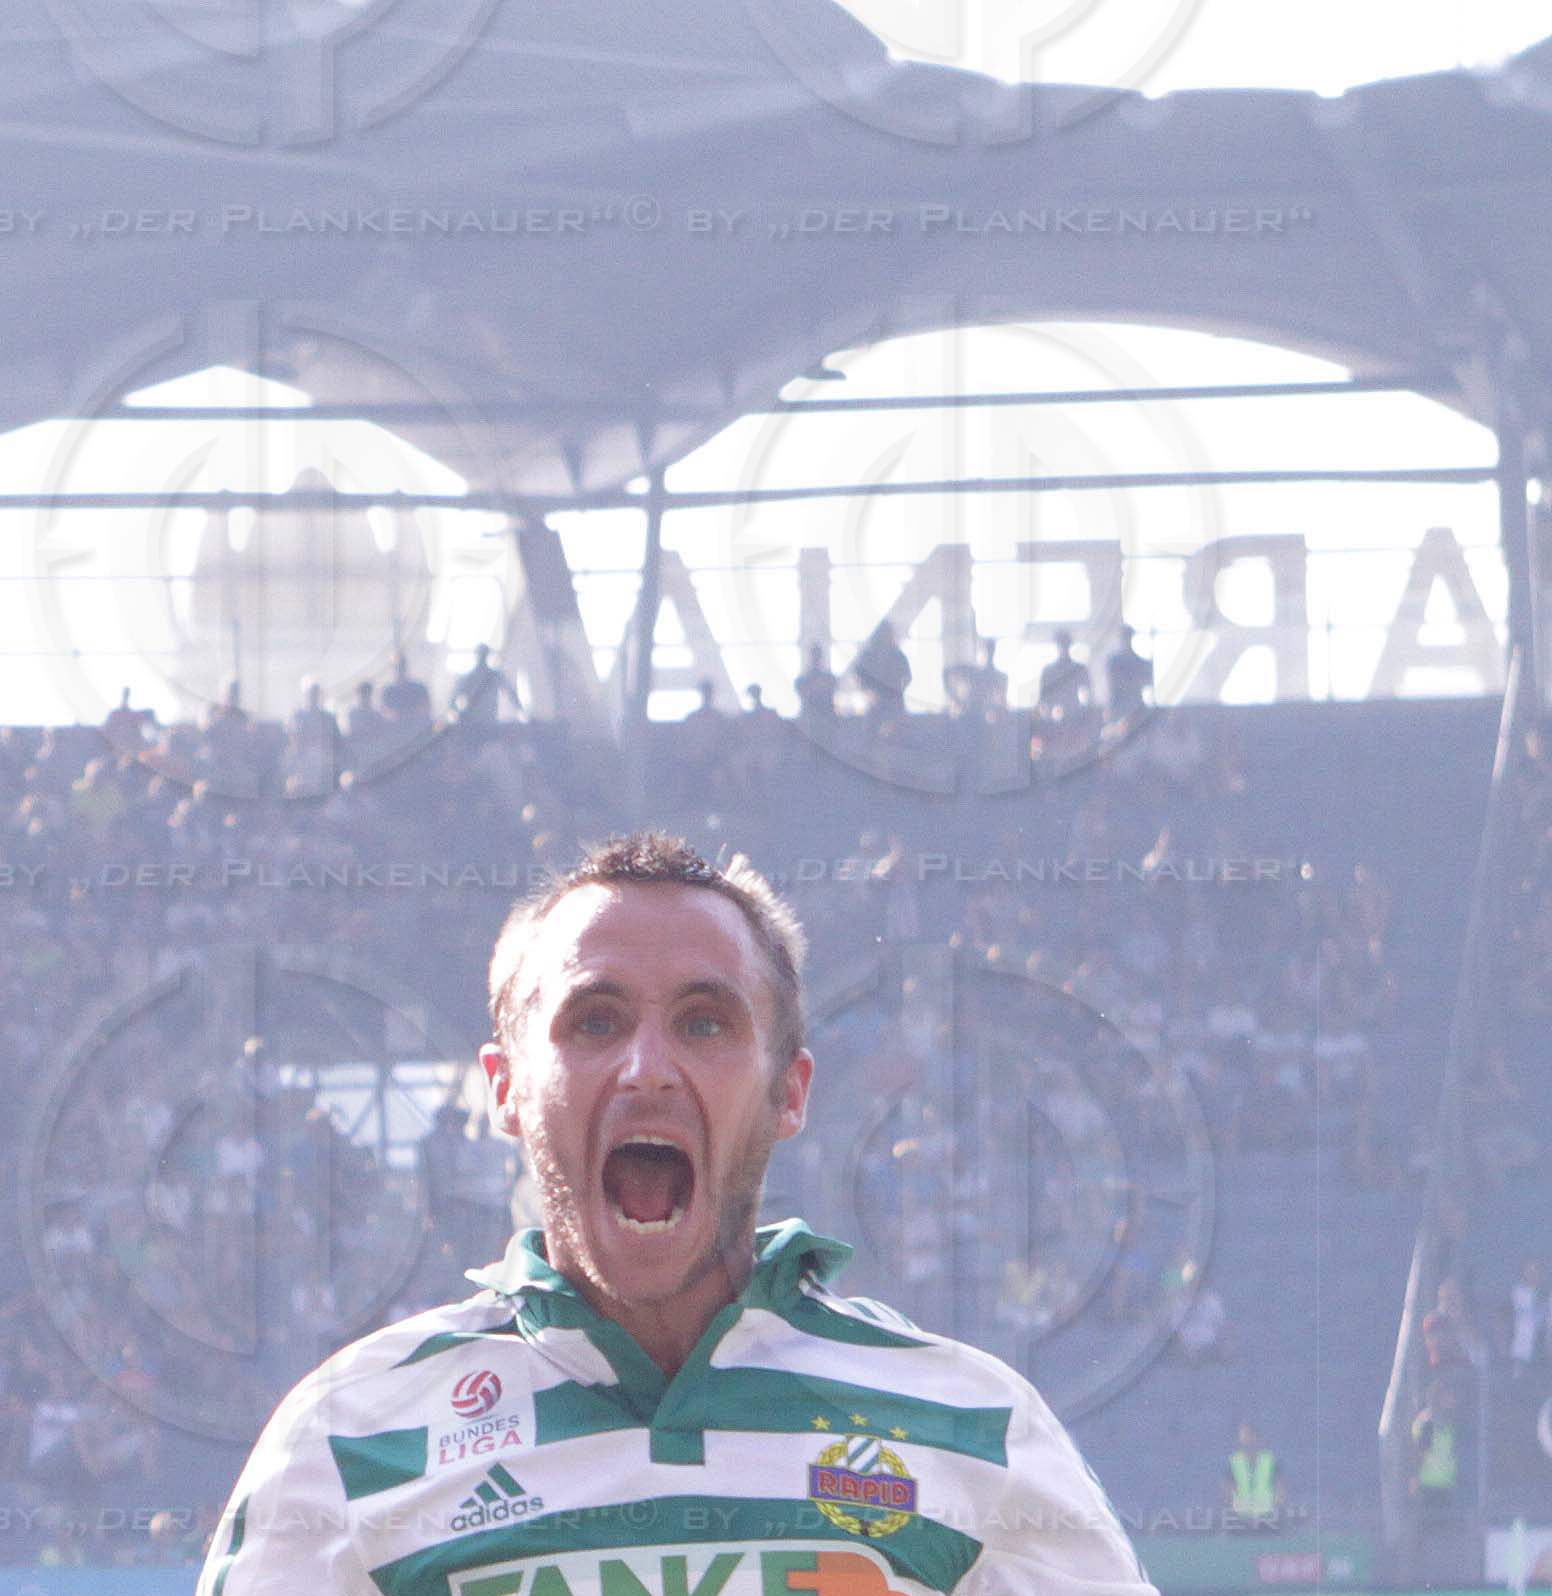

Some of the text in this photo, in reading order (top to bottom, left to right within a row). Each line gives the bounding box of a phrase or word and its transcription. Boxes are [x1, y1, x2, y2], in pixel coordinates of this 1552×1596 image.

[438, 1414, 521, 1448] BUNDES
[438, 1430, 524, 1466] LIGA
[817, 1469, 912, 1507] RAPID
[450, 1494, 545, 1532] adidas
